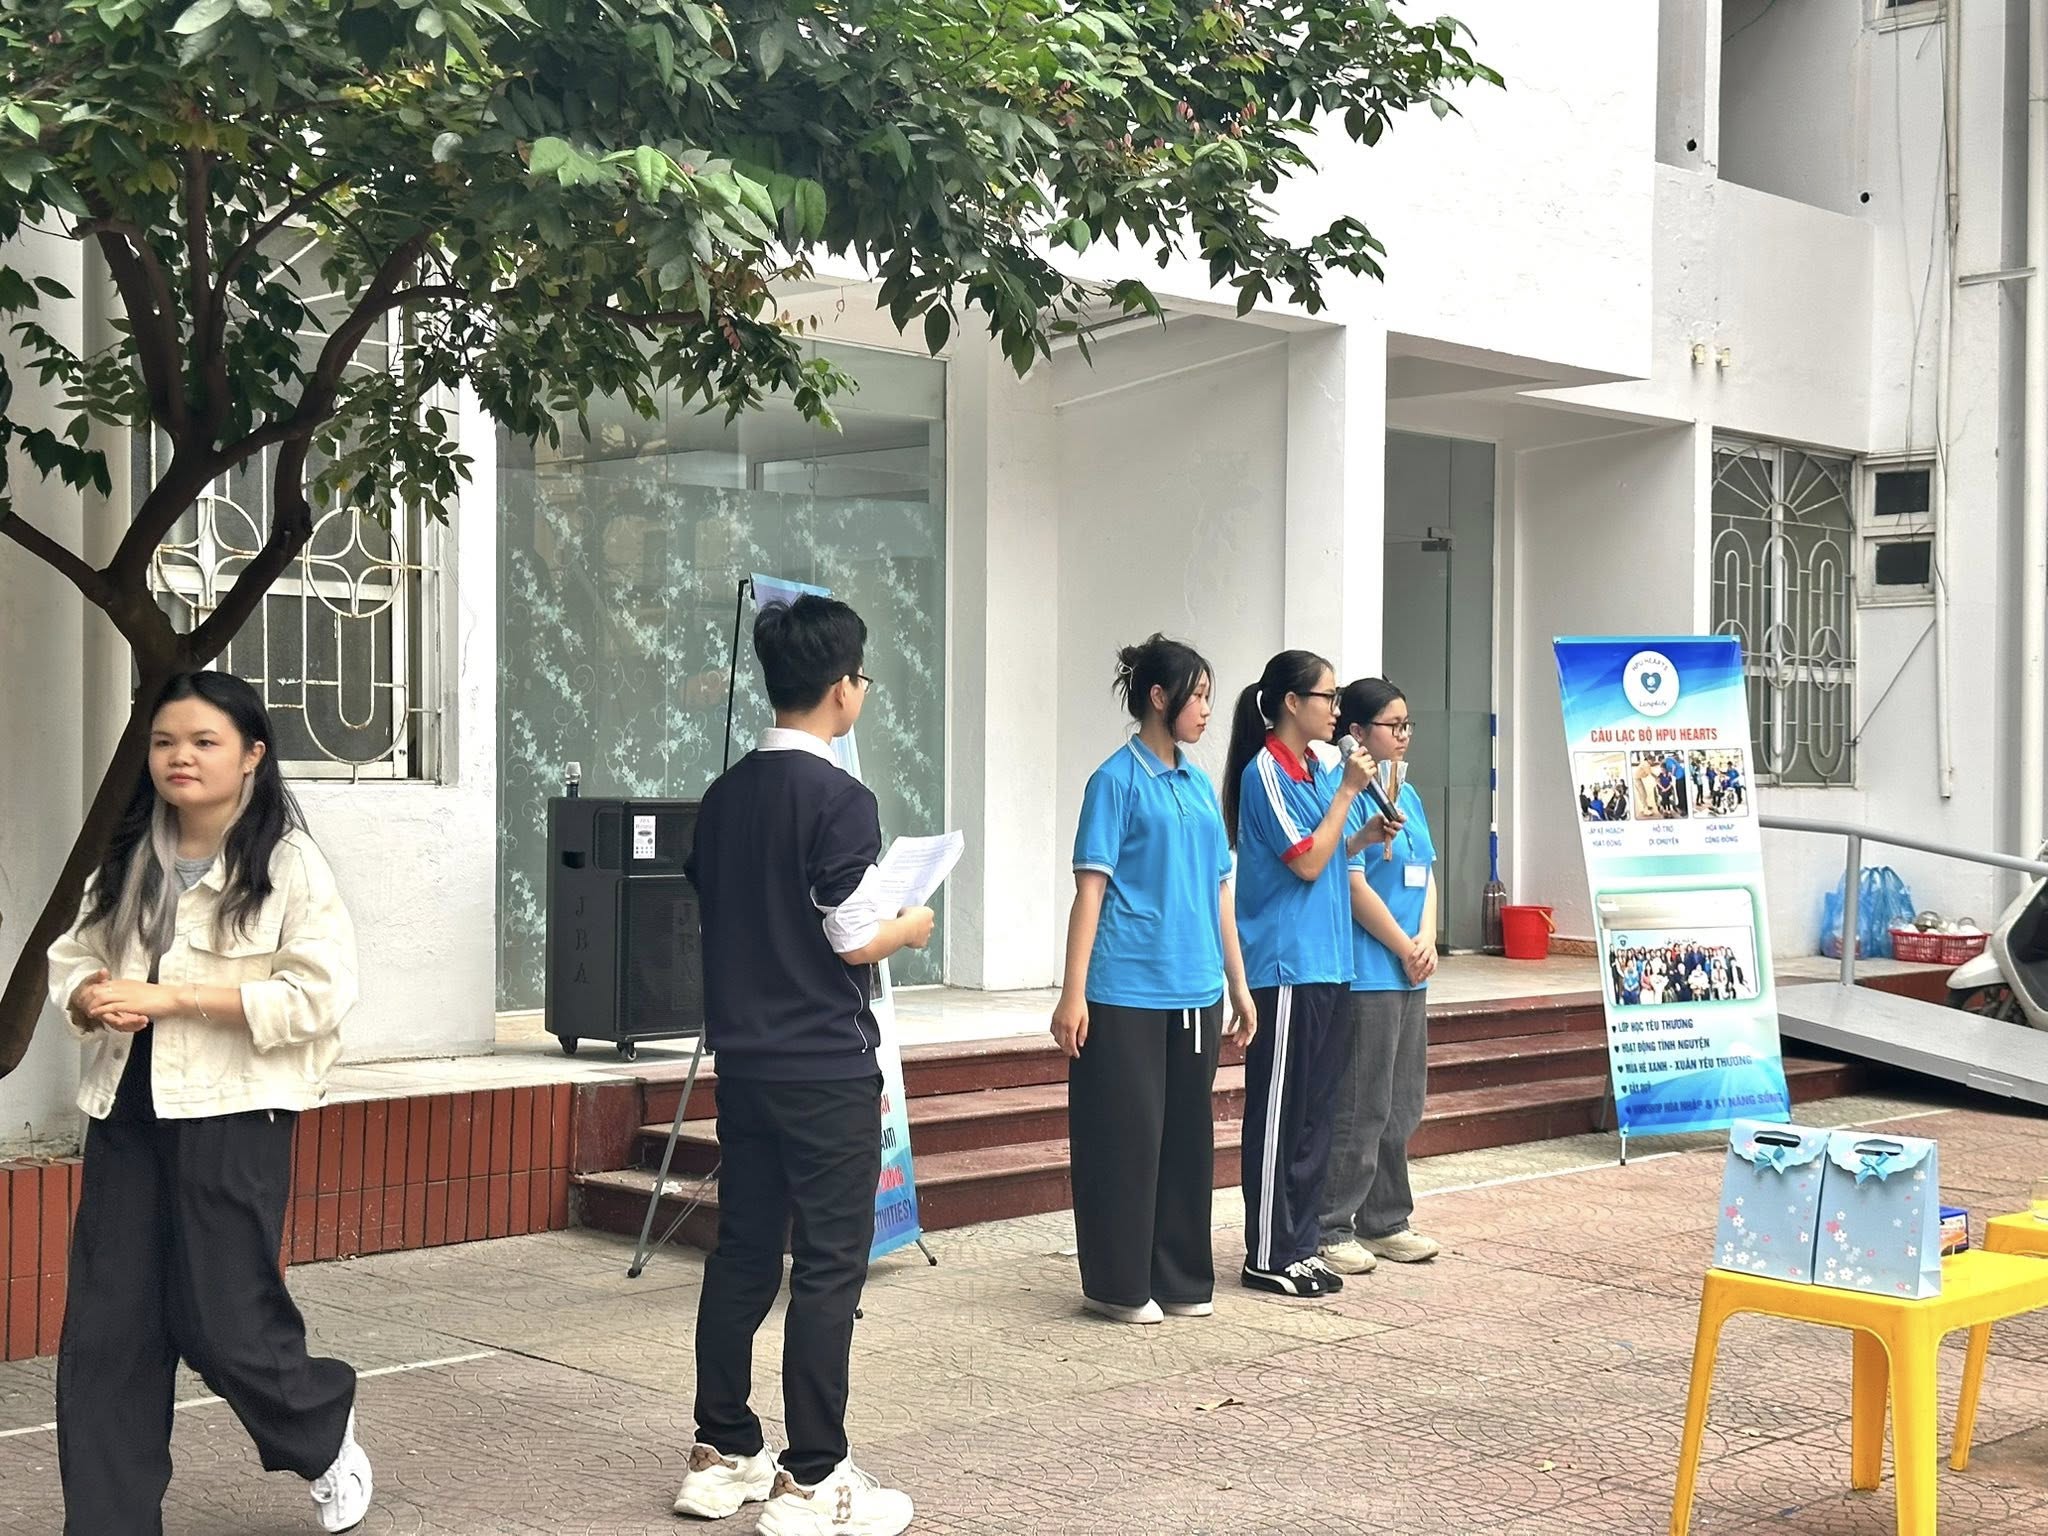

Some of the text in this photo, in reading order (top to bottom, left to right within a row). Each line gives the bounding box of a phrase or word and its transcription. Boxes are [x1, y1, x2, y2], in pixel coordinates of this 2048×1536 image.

[1591, 726, 1718, 745] CÂU LẠC BỘ HPU HEARTS
[1646, 1019, 1659, 1031] YÊU
[1661, 1018, 1694, 1030] THƯƠNG
[1678, 1036, 1711, 1051] NGUYỆN
[1648, 1061, 1668, 1072] XANH
[1674, 1057, 1697, 1070] XUÂN
[1698, 1056, 1714, 1069] YÊU
